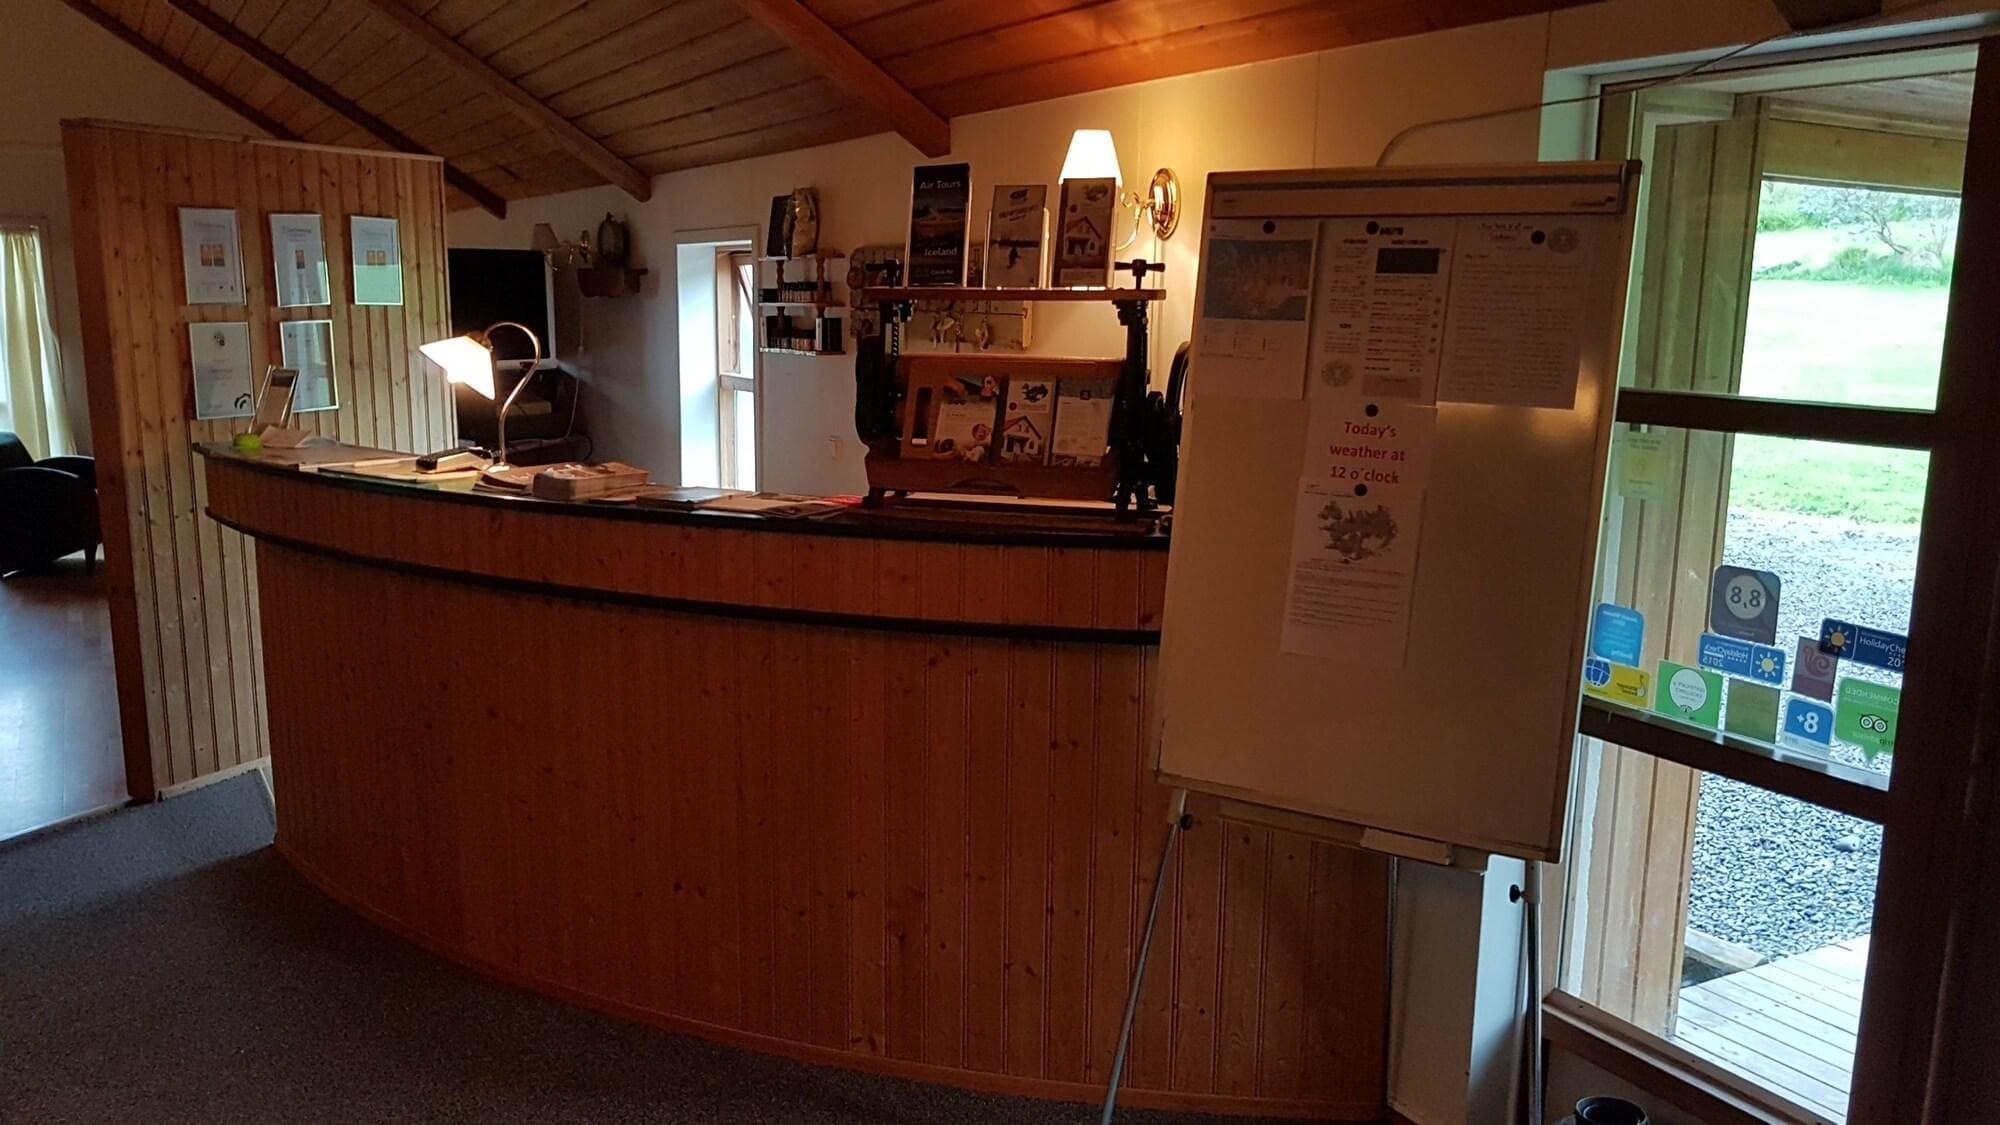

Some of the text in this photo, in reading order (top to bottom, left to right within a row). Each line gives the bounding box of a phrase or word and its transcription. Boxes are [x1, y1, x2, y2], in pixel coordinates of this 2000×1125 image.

[919, 179, 962, 190] Air Tours
[923, 246, 958, 257] Iceland
[1344, 421, 1398, 439] Today's
[1329, 445, 1406, 462] weather at
[1330, 466, 1347, 479] 12
[1730, 586, 1761, 609] 8,8
